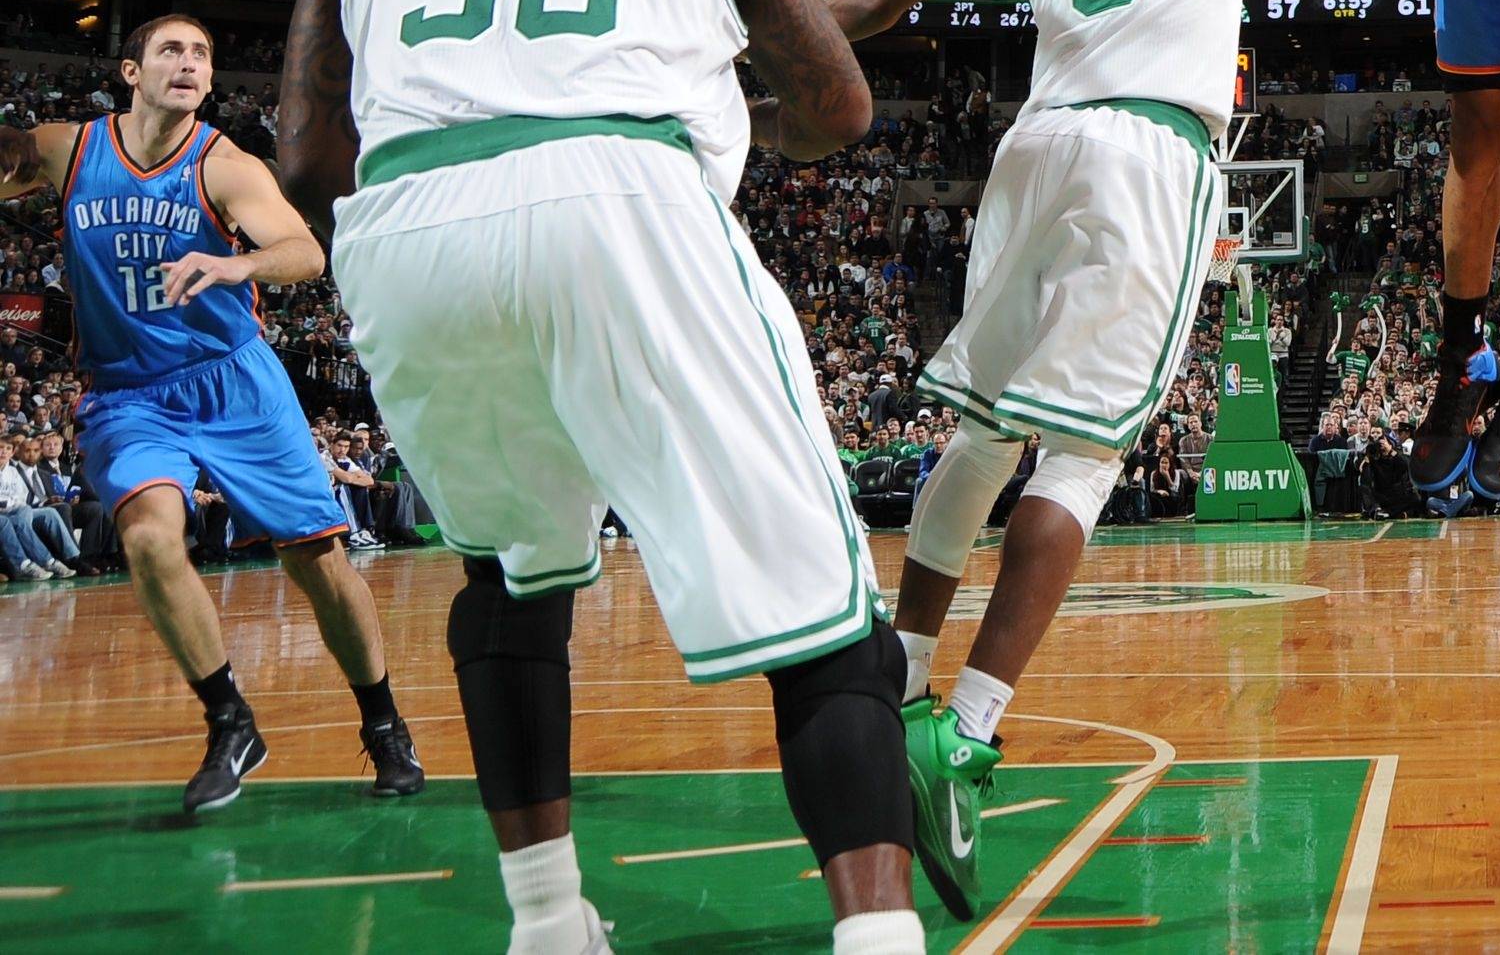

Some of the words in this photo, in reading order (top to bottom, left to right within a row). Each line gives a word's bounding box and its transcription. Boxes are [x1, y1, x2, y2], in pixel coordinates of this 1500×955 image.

[954, 2, 975, 12] 3PT
[1015, 2, 1031, 12] FG
[1334, 9, 1355, 18] QTR
[1358, 8, 1367, 19] 3
[909, 11, 920, 24] 9
[950, 12, 981, 26] 1/4
[74, 196, 200, 234] OKLAHOMA
[115, 232, 167, 260] CITY
[118, 266, 176, 313] 12
[1231, 333, 1261, 341] SPALDING
[1224, 470, 1263, 491] NBA
[1265, 469, 1290, 490] TV
